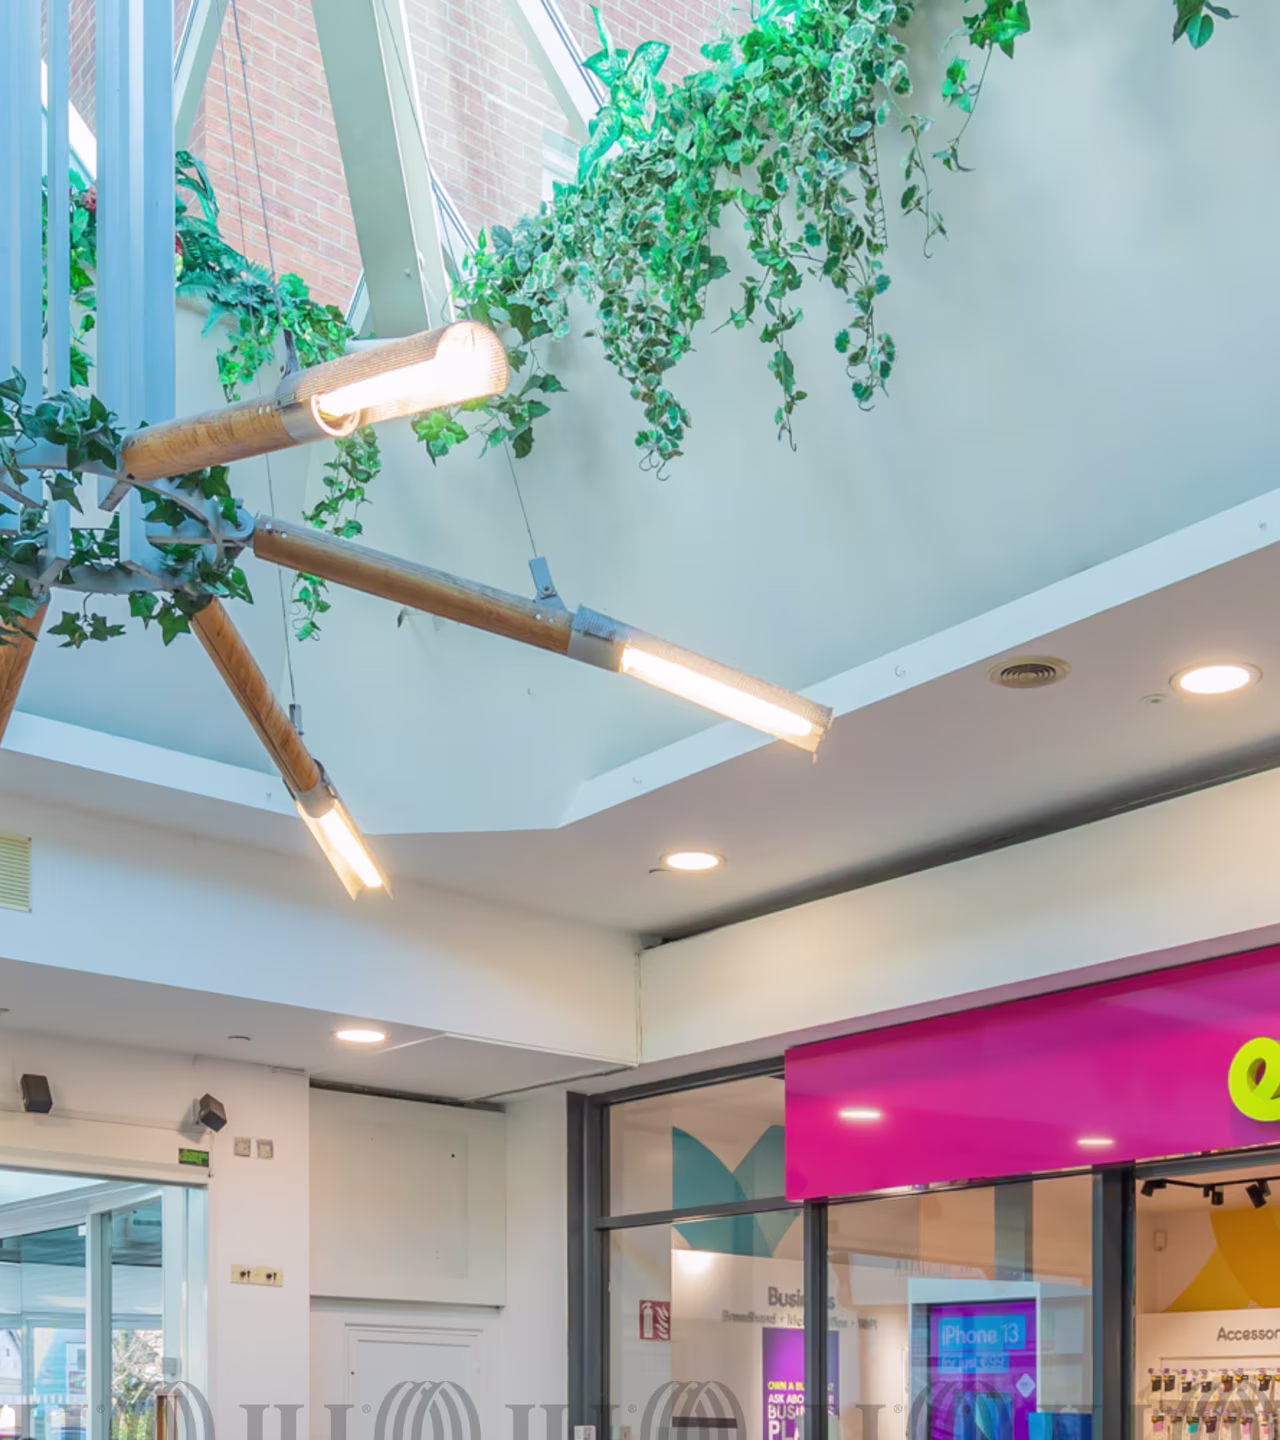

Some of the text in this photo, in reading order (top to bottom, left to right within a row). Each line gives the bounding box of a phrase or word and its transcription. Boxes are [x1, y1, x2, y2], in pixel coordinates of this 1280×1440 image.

[768, 1286, 835, 1310] Busis
[942, 1323, 1019, 1345] iPhone 13
[768, 1381, 787, 1391] OWN
[768, 1394, 805, 1404] ASK ABO
